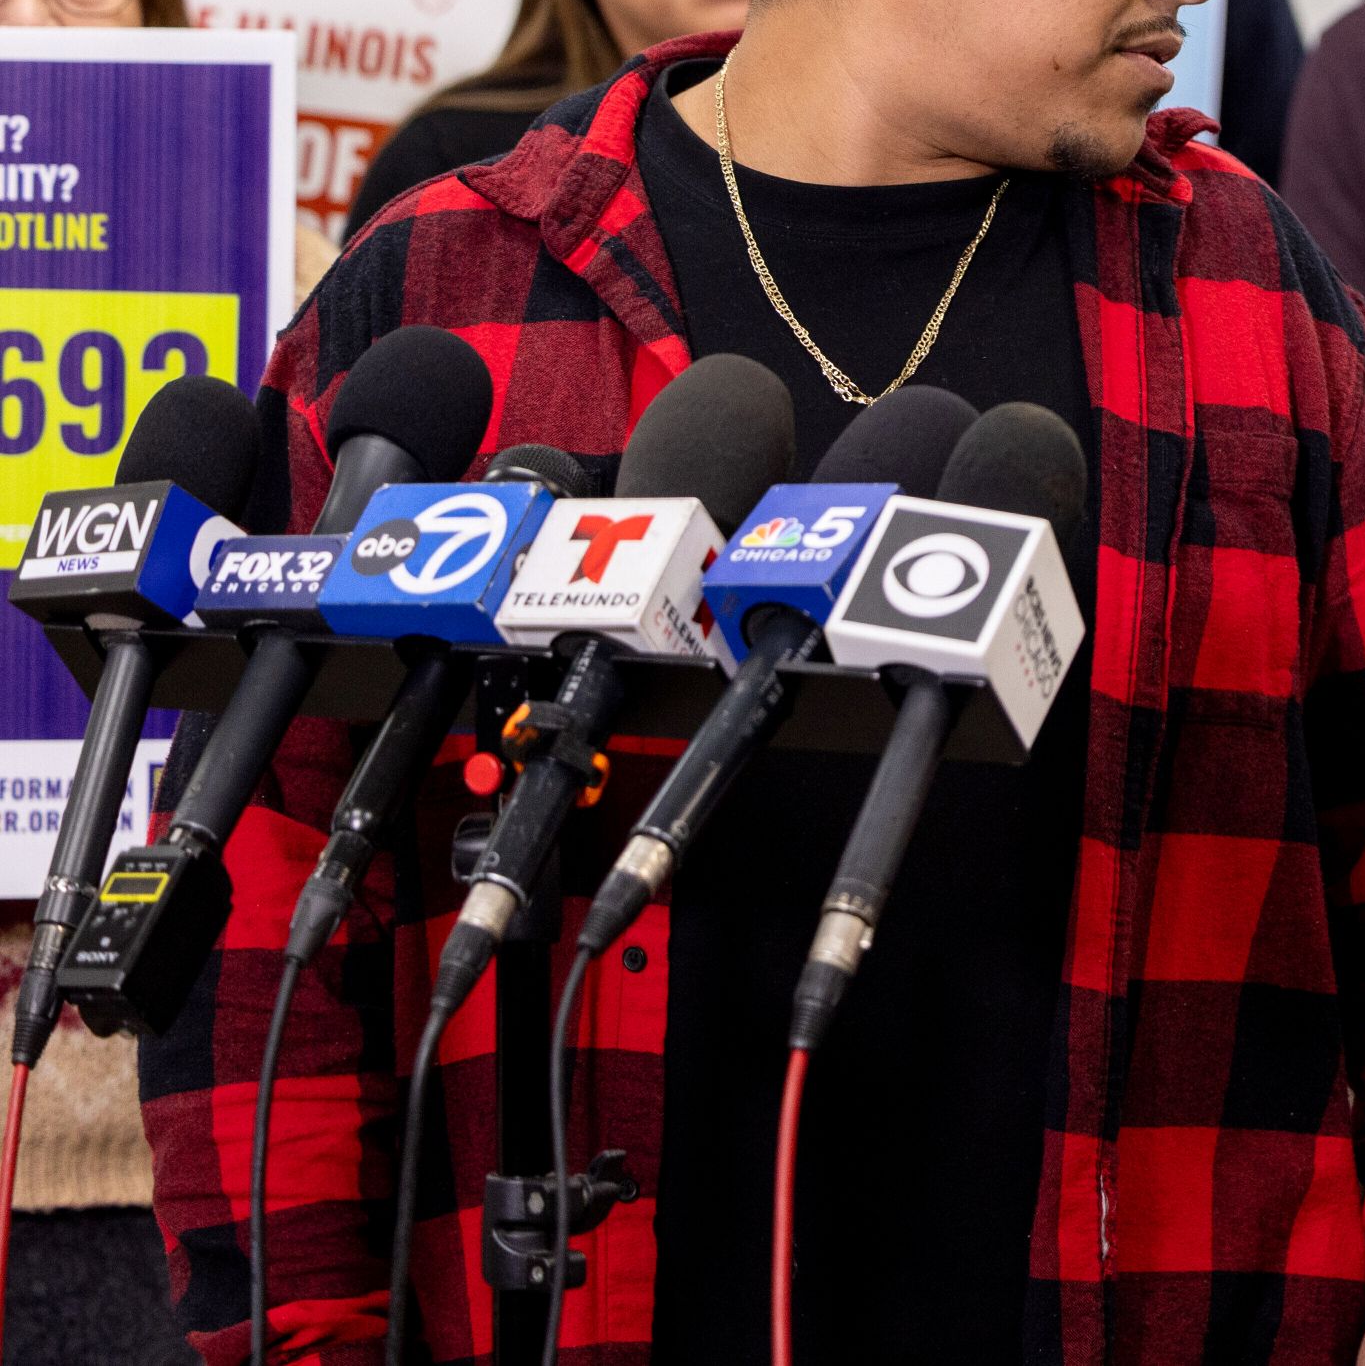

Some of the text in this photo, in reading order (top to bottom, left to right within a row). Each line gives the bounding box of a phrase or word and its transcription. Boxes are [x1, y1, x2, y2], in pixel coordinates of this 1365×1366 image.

[0, 162, 80, 203] ITY?
[36, 499, 158, 558] WGN
[802, 506, 868, 549] 5
[355, 533, 417, 559] abc
[729, 548, 834, 563] CHICAGO
[57, 556, 100, 573] NEWS
[215, 550, 294, 583] FOX
[286, 550, 334, 582] 32
[210, 581, 321, 595] CHICAGO
[511, 591, 641, 608] TELEMUNDO
